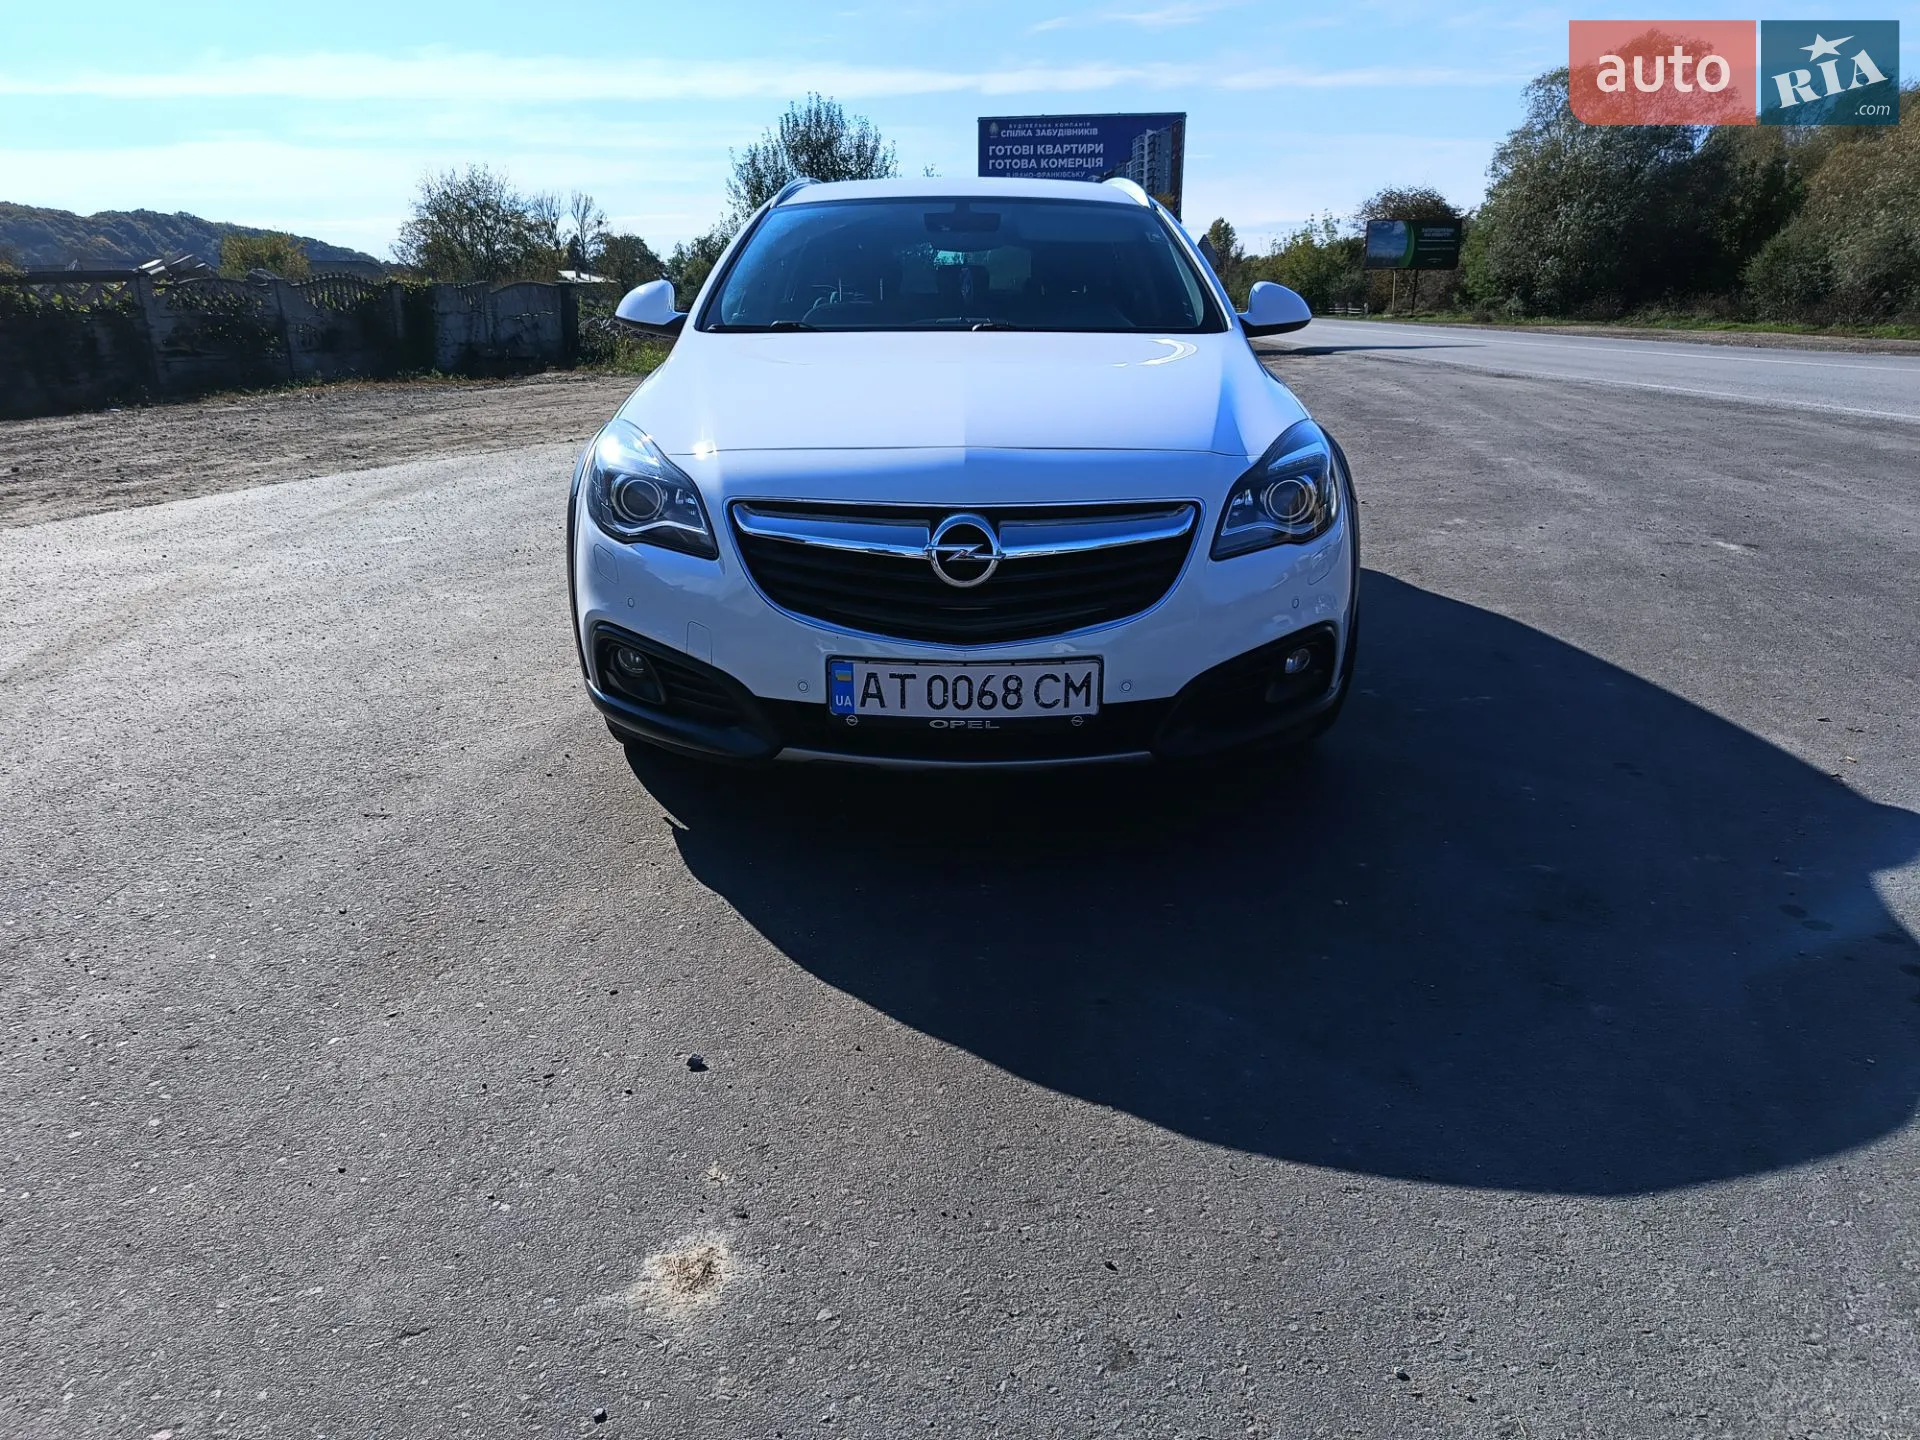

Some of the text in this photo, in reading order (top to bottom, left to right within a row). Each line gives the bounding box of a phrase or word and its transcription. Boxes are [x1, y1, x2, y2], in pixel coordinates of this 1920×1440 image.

[1001, 128, 1098, 137] СПІЛКА ЗАБУДІВНИКІВ
[989, 143, 1104, 156] ГОТОВІ КВАРТИРИ
[989, 157, 1104, 170] ГОТОВА КОМЕРЦІЯ
[859, 671, 1093, 711] AT 0068 CM
[835, 695, 853, 708] UA
[929, 719, 1000, 729] OPEL
